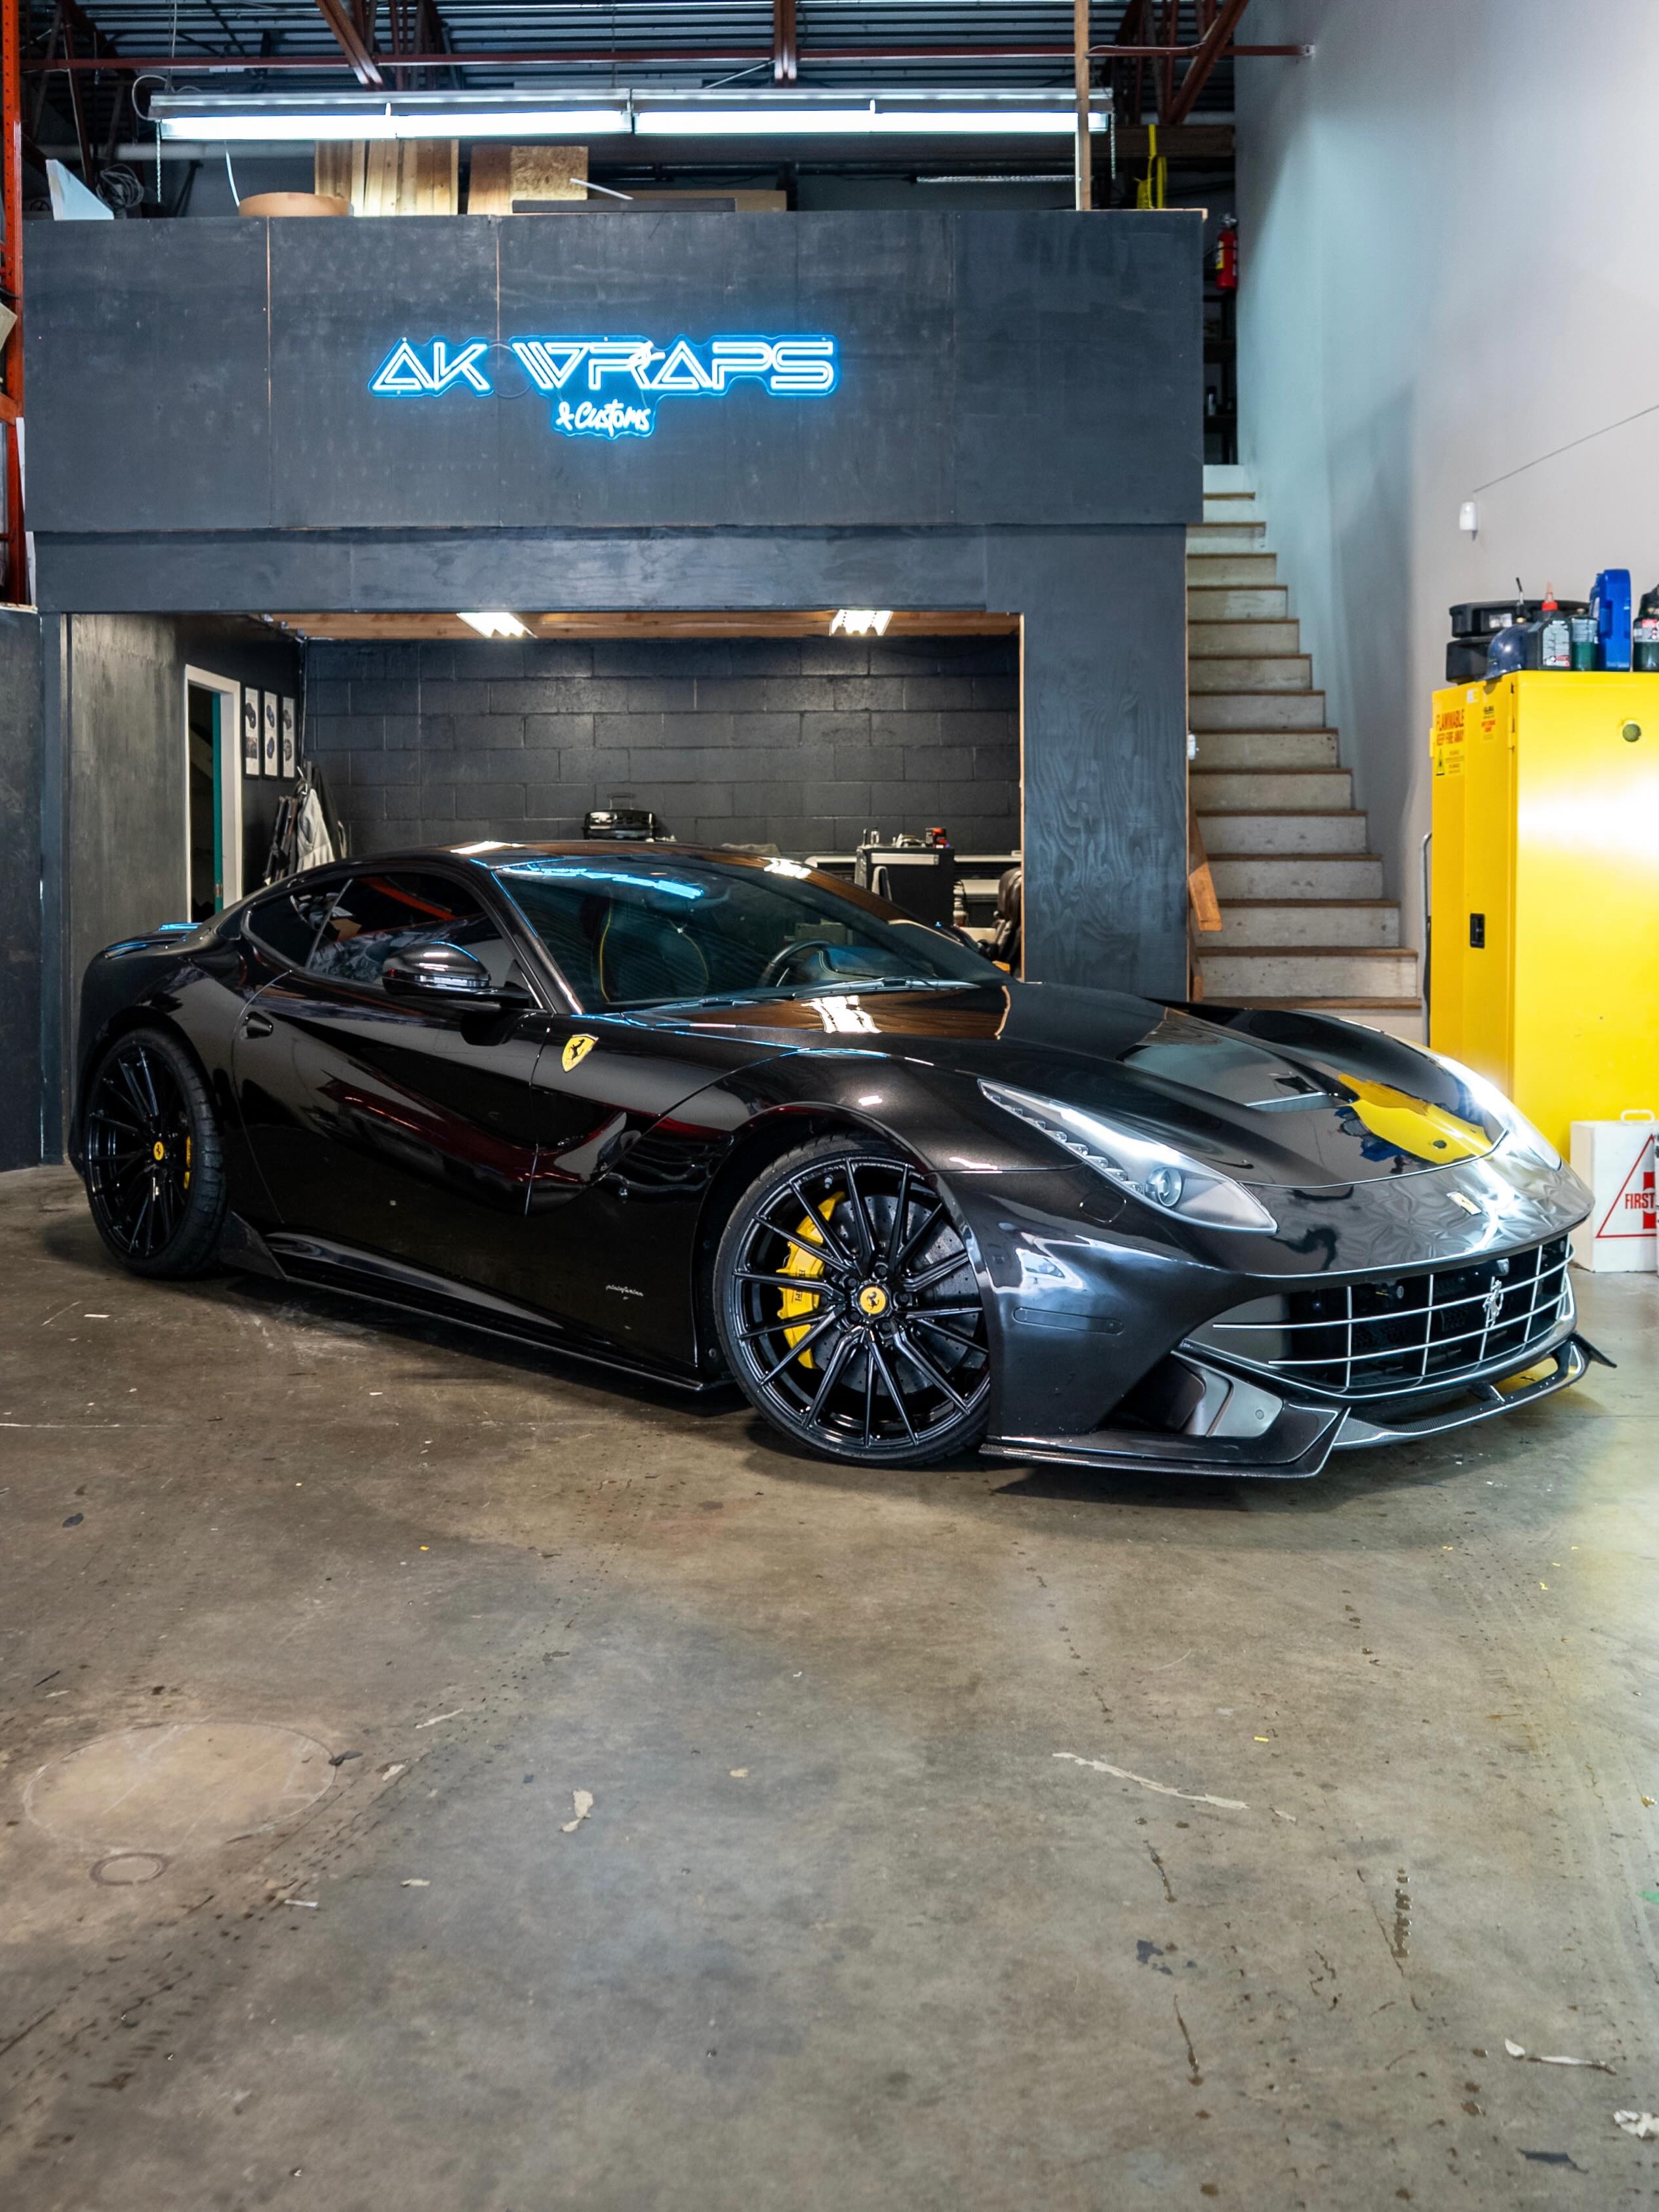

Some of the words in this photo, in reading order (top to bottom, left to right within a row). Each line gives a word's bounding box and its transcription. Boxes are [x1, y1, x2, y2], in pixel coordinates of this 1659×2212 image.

[372, 341, 490, 391] AK
[511, 340, 833, 391] WRAPS
[1625, 1192, 1655, 1209] FIRST
